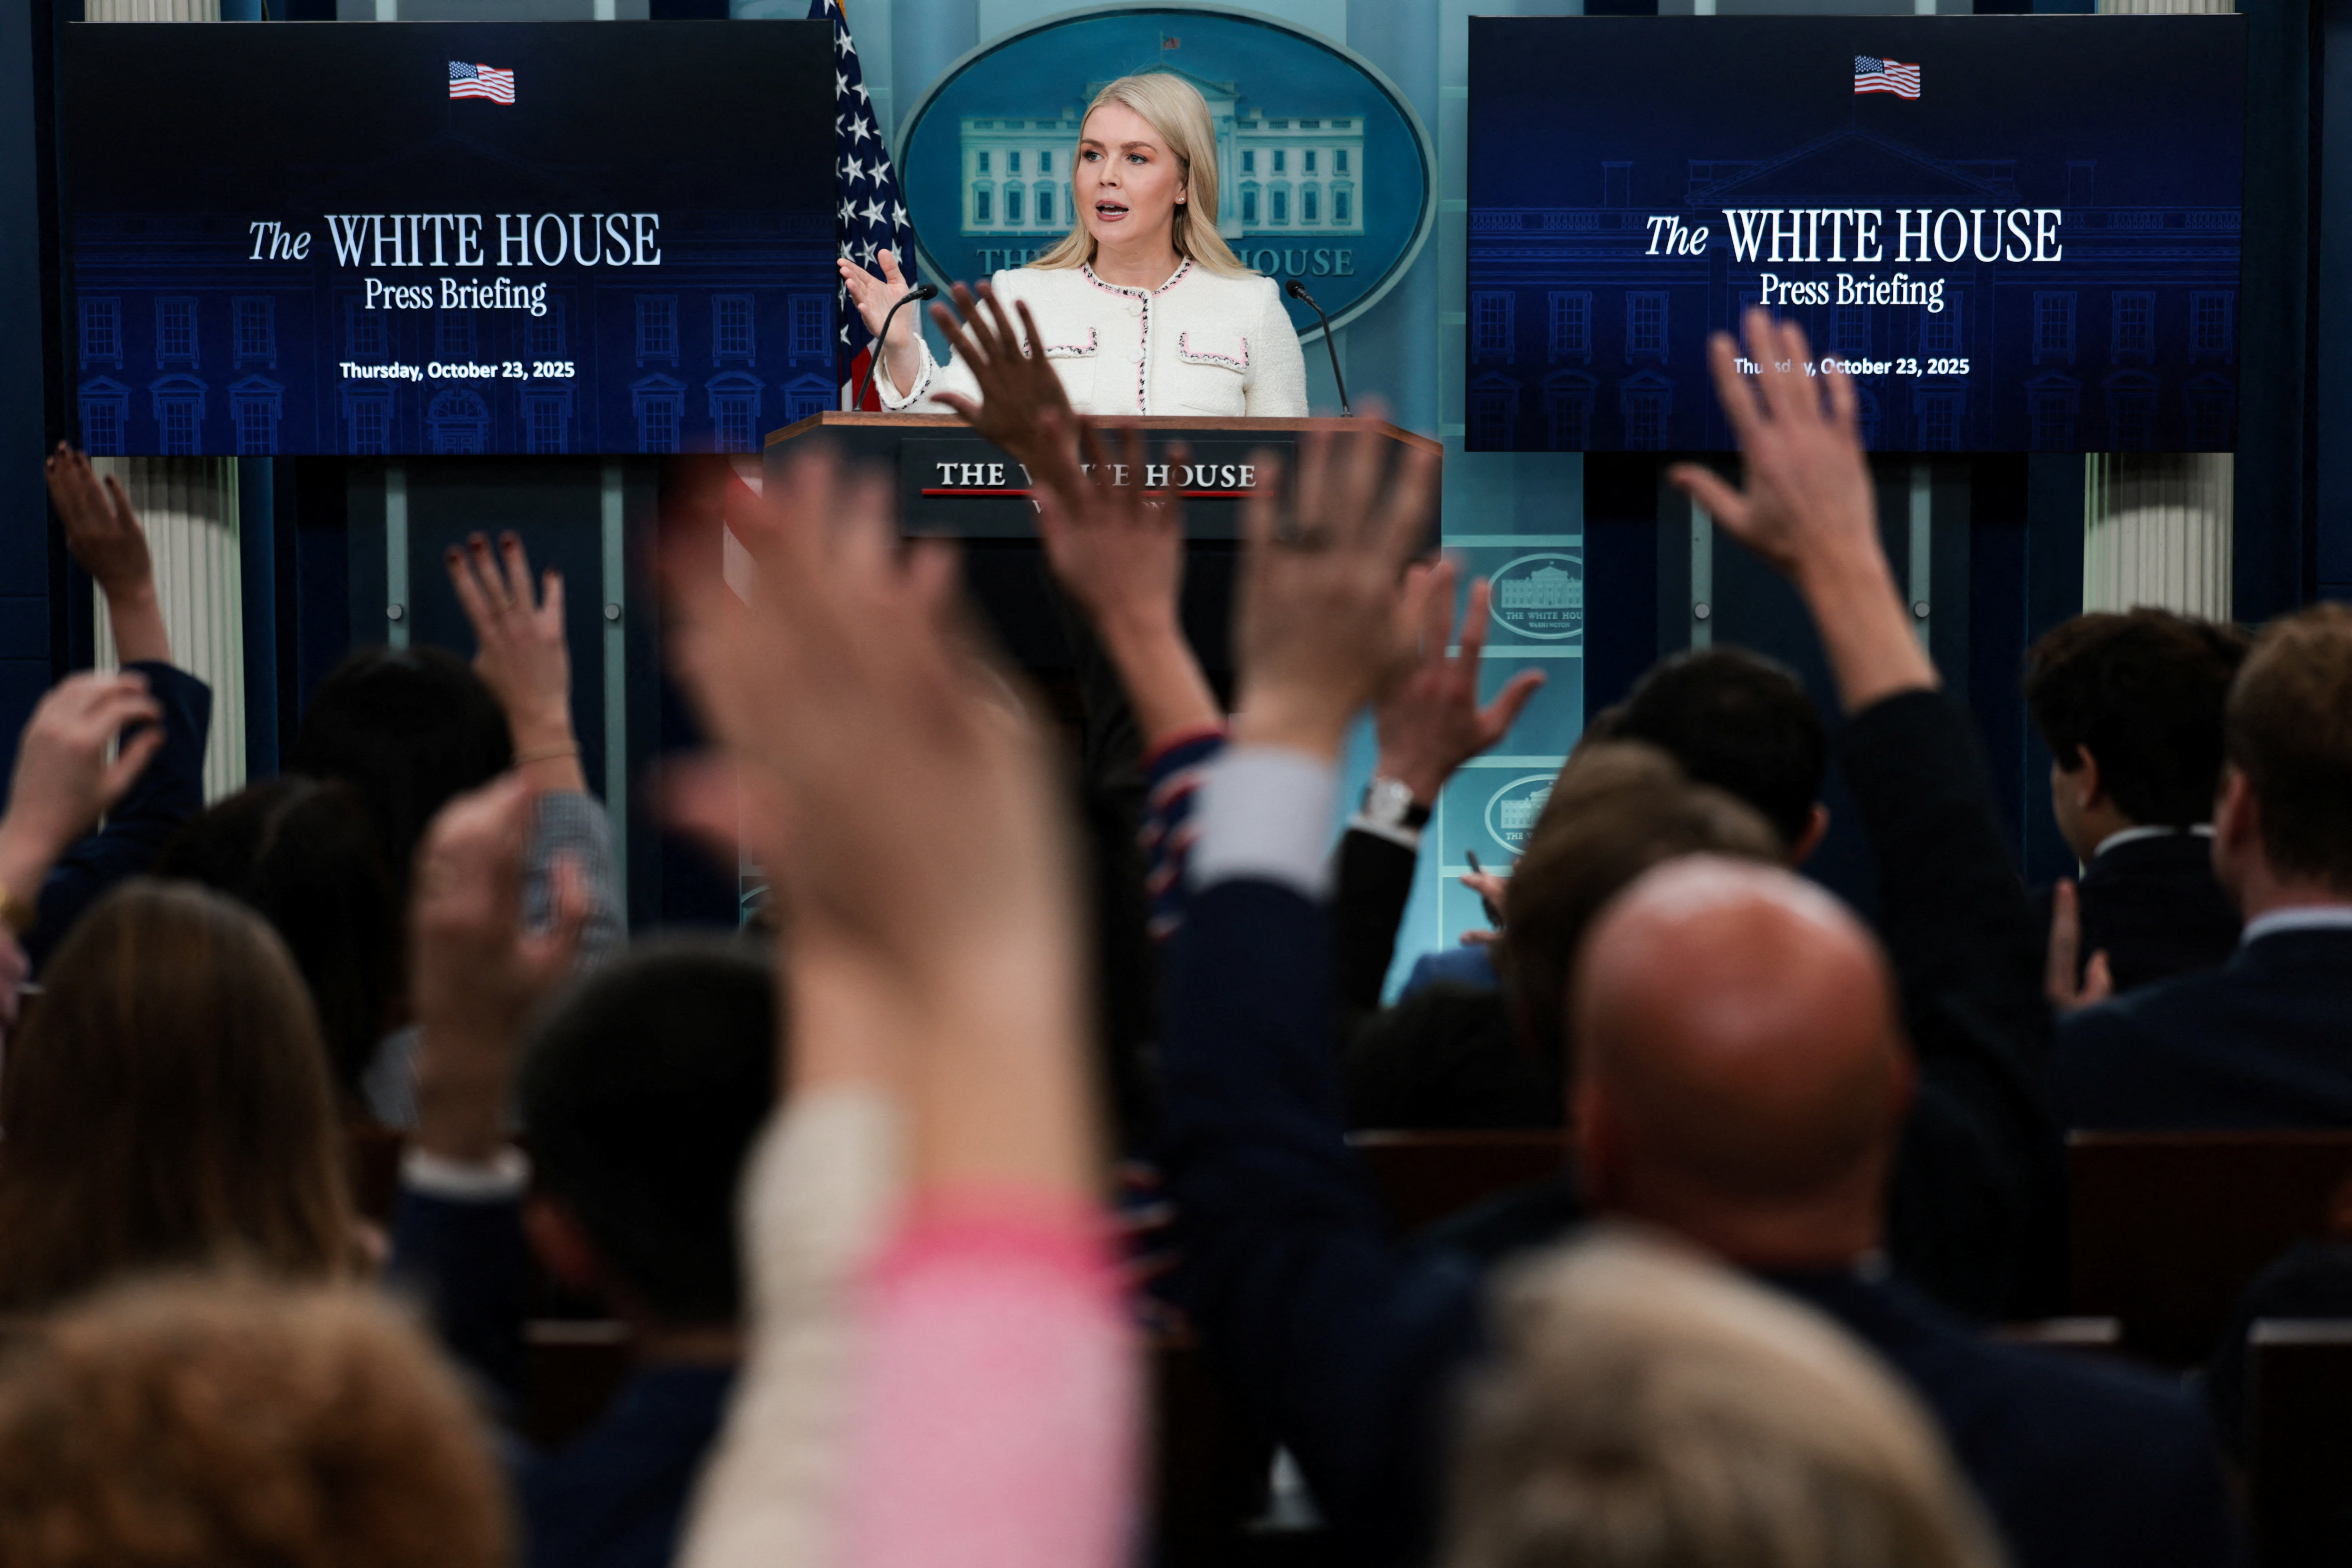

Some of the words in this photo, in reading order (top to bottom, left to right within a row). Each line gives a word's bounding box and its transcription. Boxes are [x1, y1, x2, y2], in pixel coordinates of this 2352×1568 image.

[249, 221, 311, 260] The
[324, 214, 484, 268] WHITE
[496, 213, 661, 267] HOUSE
[1645, 215, 1709, 256] The
[1721, 208, 1883, 263] WHITE
[1894, 208, 2063, 263] HOUSE
[364, 278, 434, 309] Press
[439, 277, 547, 317] Briefing
[1759, 273, 1830, 305] Press
[1835, 272, 1945, 313] Briefing
[339, 361, 424, 382] Thursday,
[427, 361, 499, 379] October
[501, 361, 529, 381] 23,
[533, 361, 575, 378] 2025
[1733, 358, 1816, 377] Thusdy,
[1821, 357, 1892, 375] October
[1896, 358, 1923, 378] 23,
[1927, 358, 1970, 375] 2025
[936, 462, 1006, 486] THE
[1145, 464, 1257, 488] HOUSE
